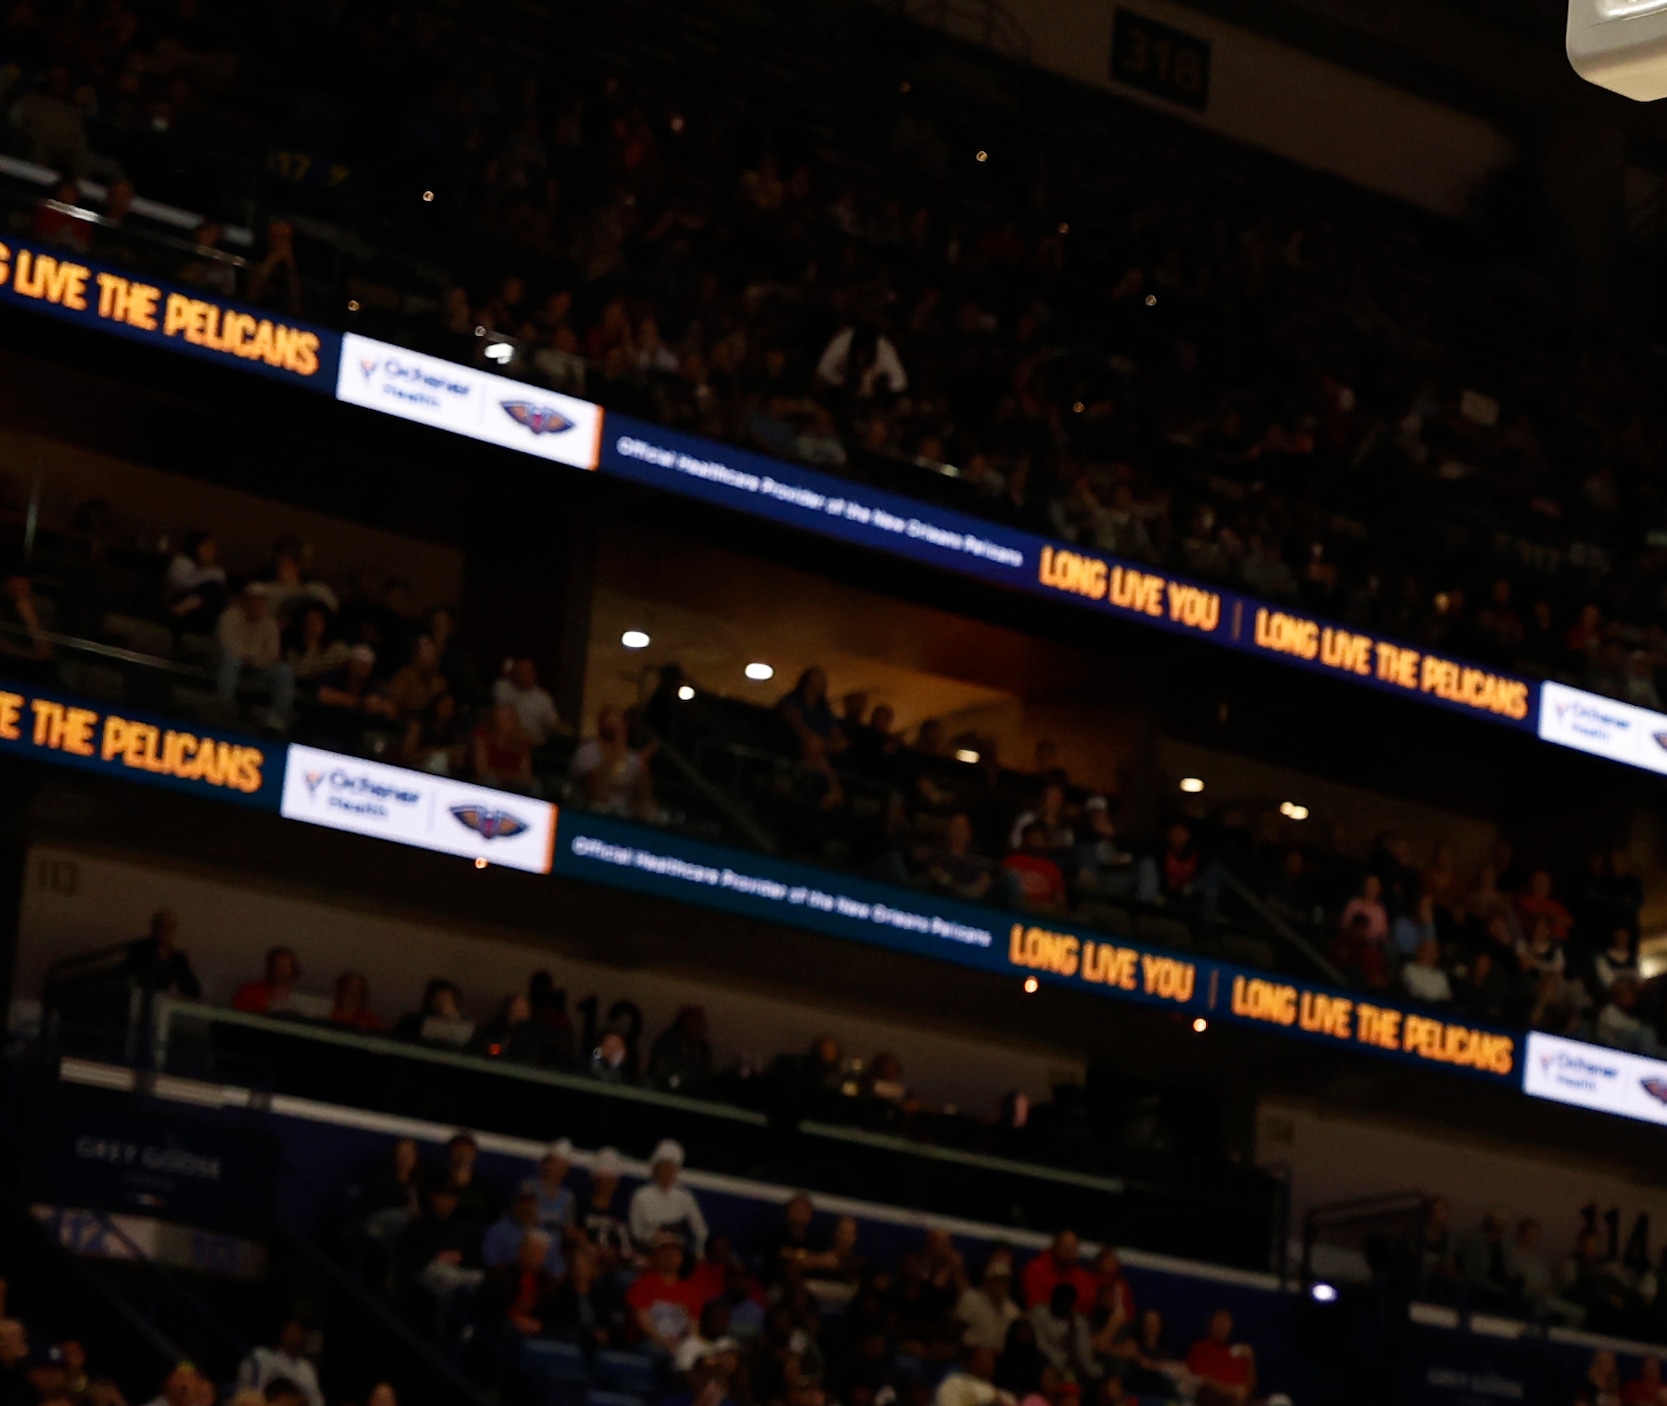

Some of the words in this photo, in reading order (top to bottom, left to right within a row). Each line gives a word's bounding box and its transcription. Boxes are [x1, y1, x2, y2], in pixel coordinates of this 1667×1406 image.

[13, 248, 90, 311] LIVE
[96, 271, 161, 331] THE
[163, 293, 319, 376] PELICANS
[1039, 545, 1109, 600] LONG
[1109, 565, 1166, 617] LIVE
[1167, 579, 1220, 631] YOU
[1254, 607, 1320, 661] LONG
[1321, 627, 1374, 675] LIVE
[1376, 640, 1420, 689] THE
[1421, 655, 1529, 720] PELICANS
[31, 699, 97, 757] THE
[101, 716, 264, 793] PELICANS
[1008, 923, 1081, 977] LONG
[1081, 940, 1139, 991] LIVE
[1142, 953, 1196, 1003] YOU
[1231, 974, 1299, 1026] LONG
[1299, 990, 1353, 1039] LIVE
[1356, 1002, 1402, 1051] THE
[1403, 1014, 1515, 1077] PELICANS
